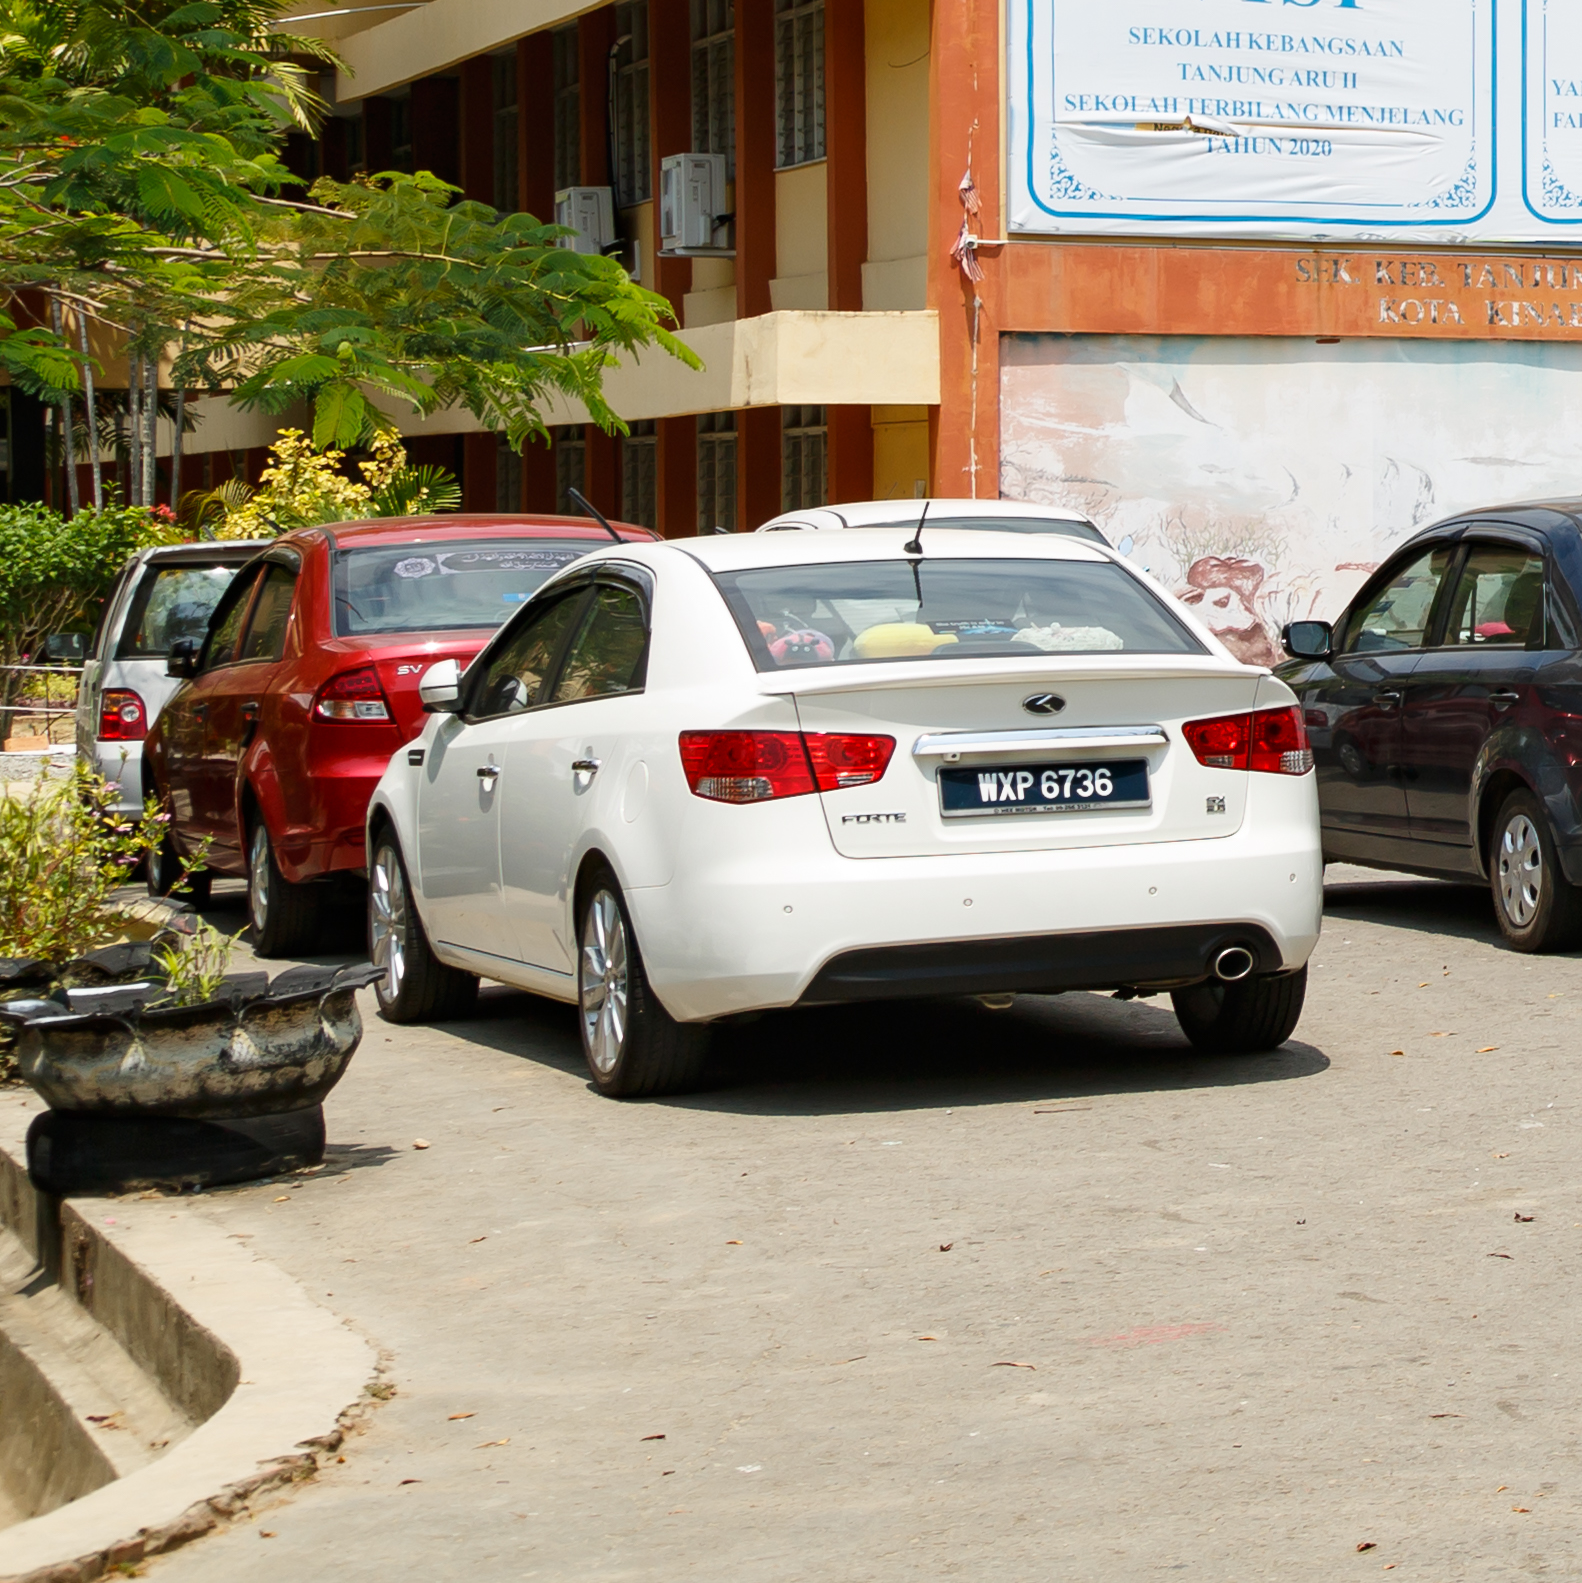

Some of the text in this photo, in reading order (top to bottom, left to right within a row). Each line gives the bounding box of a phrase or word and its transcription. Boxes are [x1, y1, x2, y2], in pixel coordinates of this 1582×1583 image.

[1129, 27, 1403, 57] SEKOLAH KEBANGSAAN
[1177, 63, 1357, 89] TANJUNG ARU II
[1065, 94, 1464, 126] SEKOLAH TERBILANG MENJELANG
[1204, 136, 1333, 156] TAHUN 2020
[1295, 258, 1361, 285] SEK.
[1374, 259, 1446, 288] KEB.
[1379, 297, 1464, 325] KOTA
[397, 664, 423, 675] SV
[978, 768, 1113, 802] WXP 6736
[841, 811, 907, 826] FORTE
